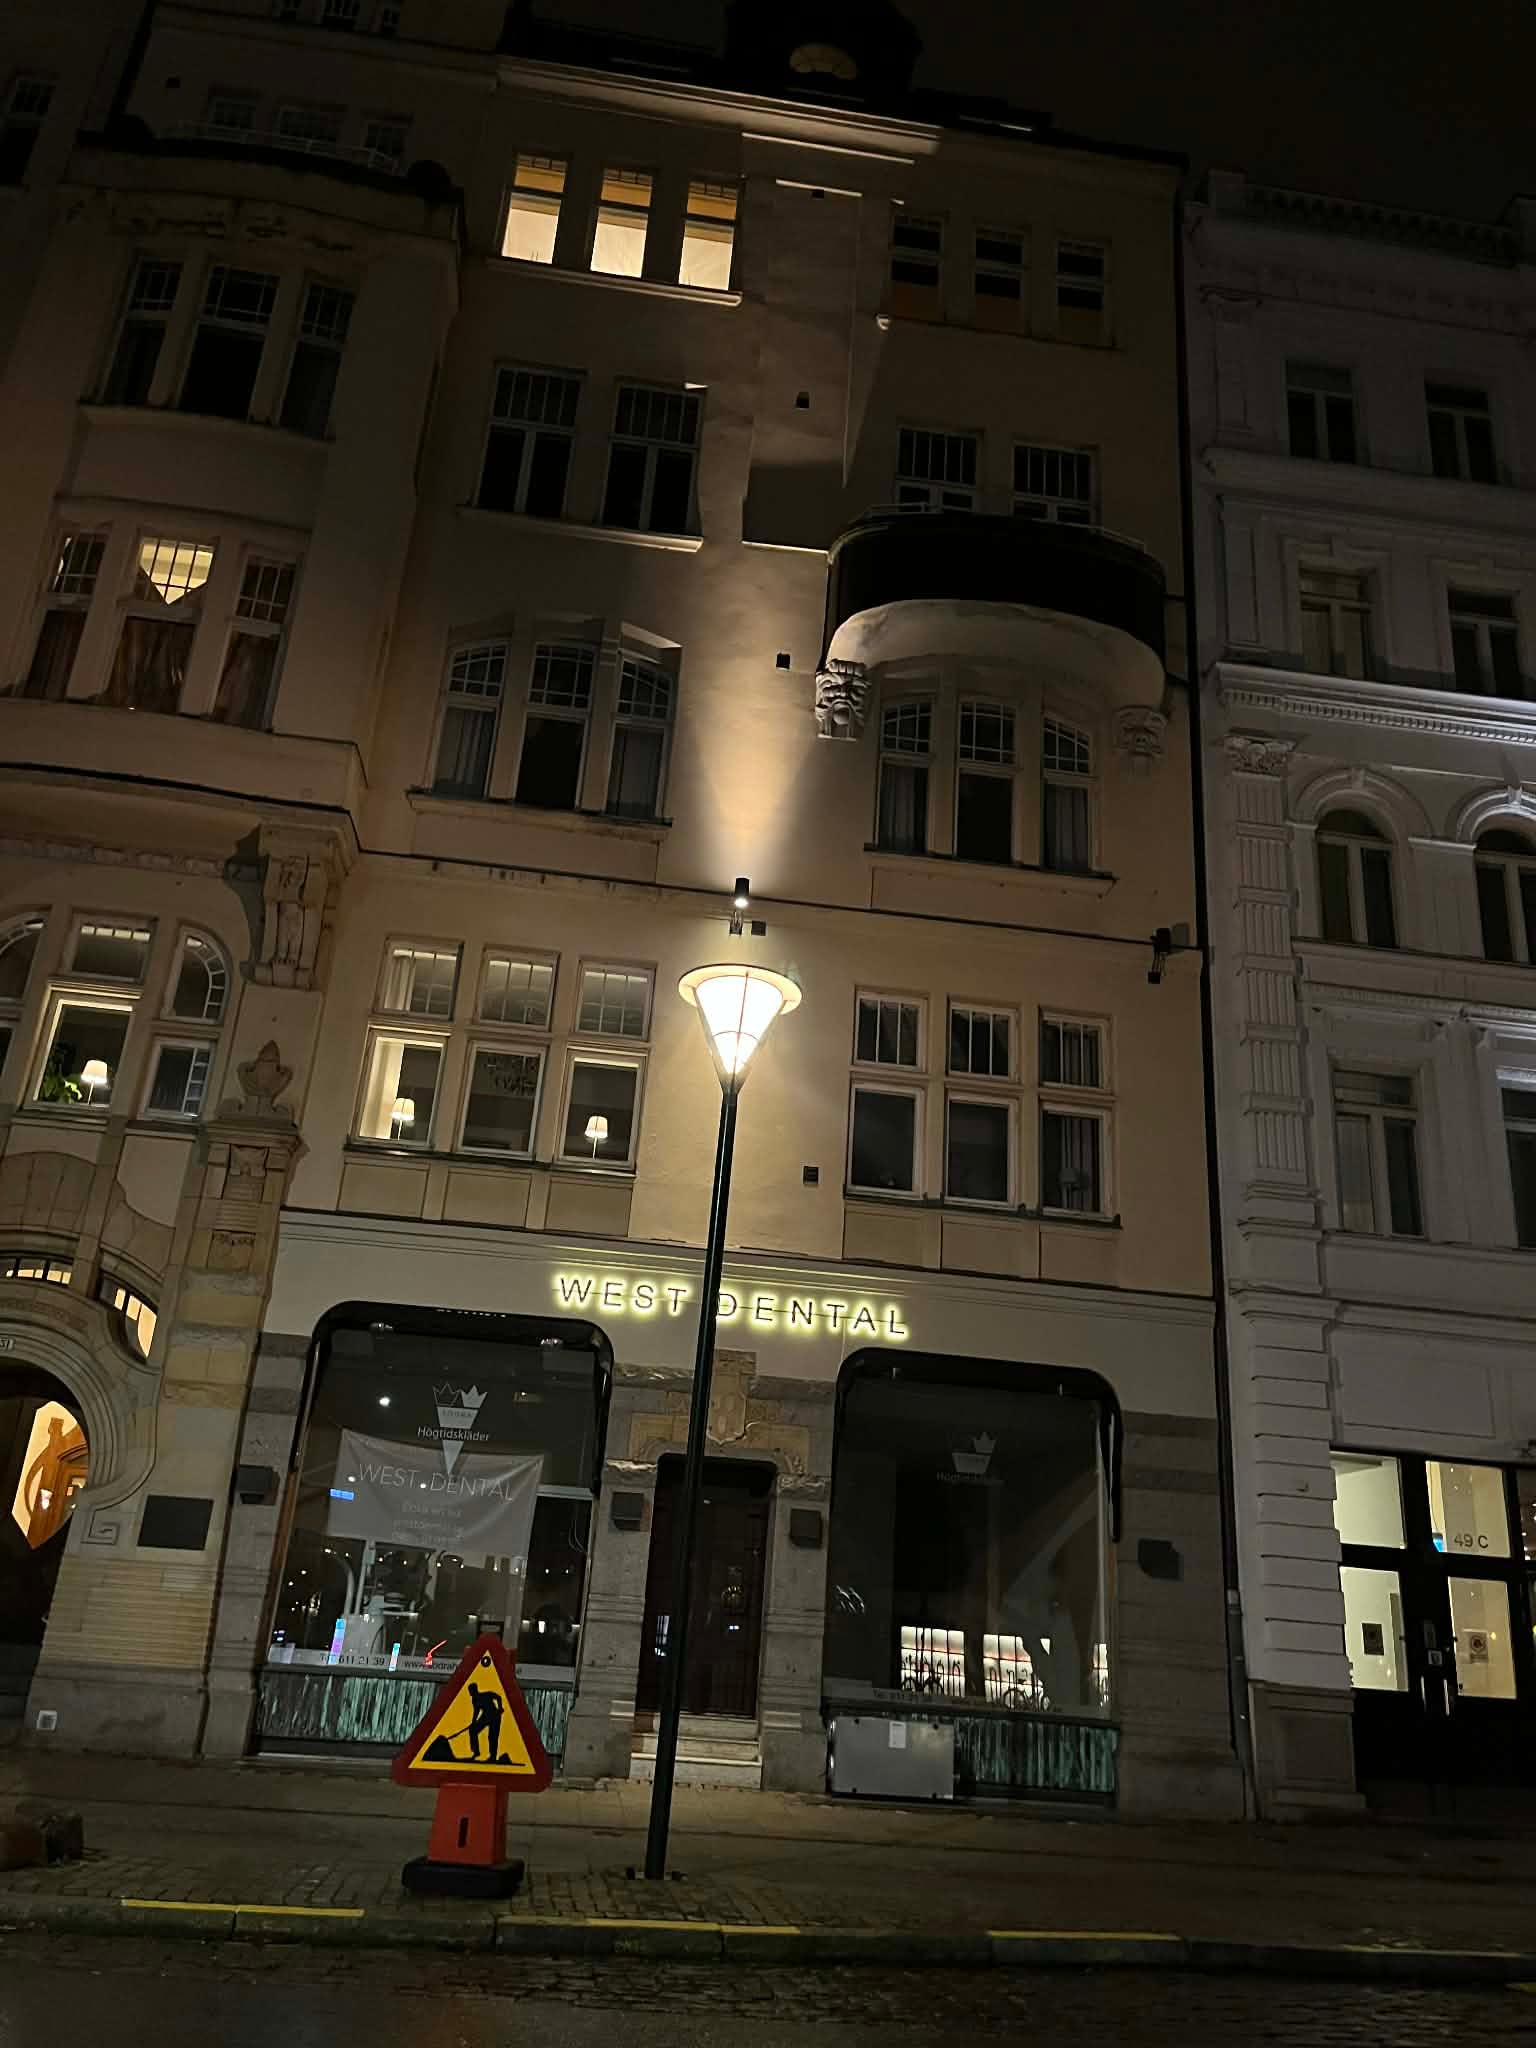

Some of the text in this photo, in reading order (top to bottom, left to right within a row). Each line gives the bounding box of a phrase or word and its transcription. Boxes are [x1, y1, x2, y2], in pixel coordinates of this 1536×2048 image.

[559, 1277, 906, 1335] WEST DENTAL
[359, 1463, 512, 1500] WEST DENTAL
[1454, 1533, 1489, 1549] 49 C
